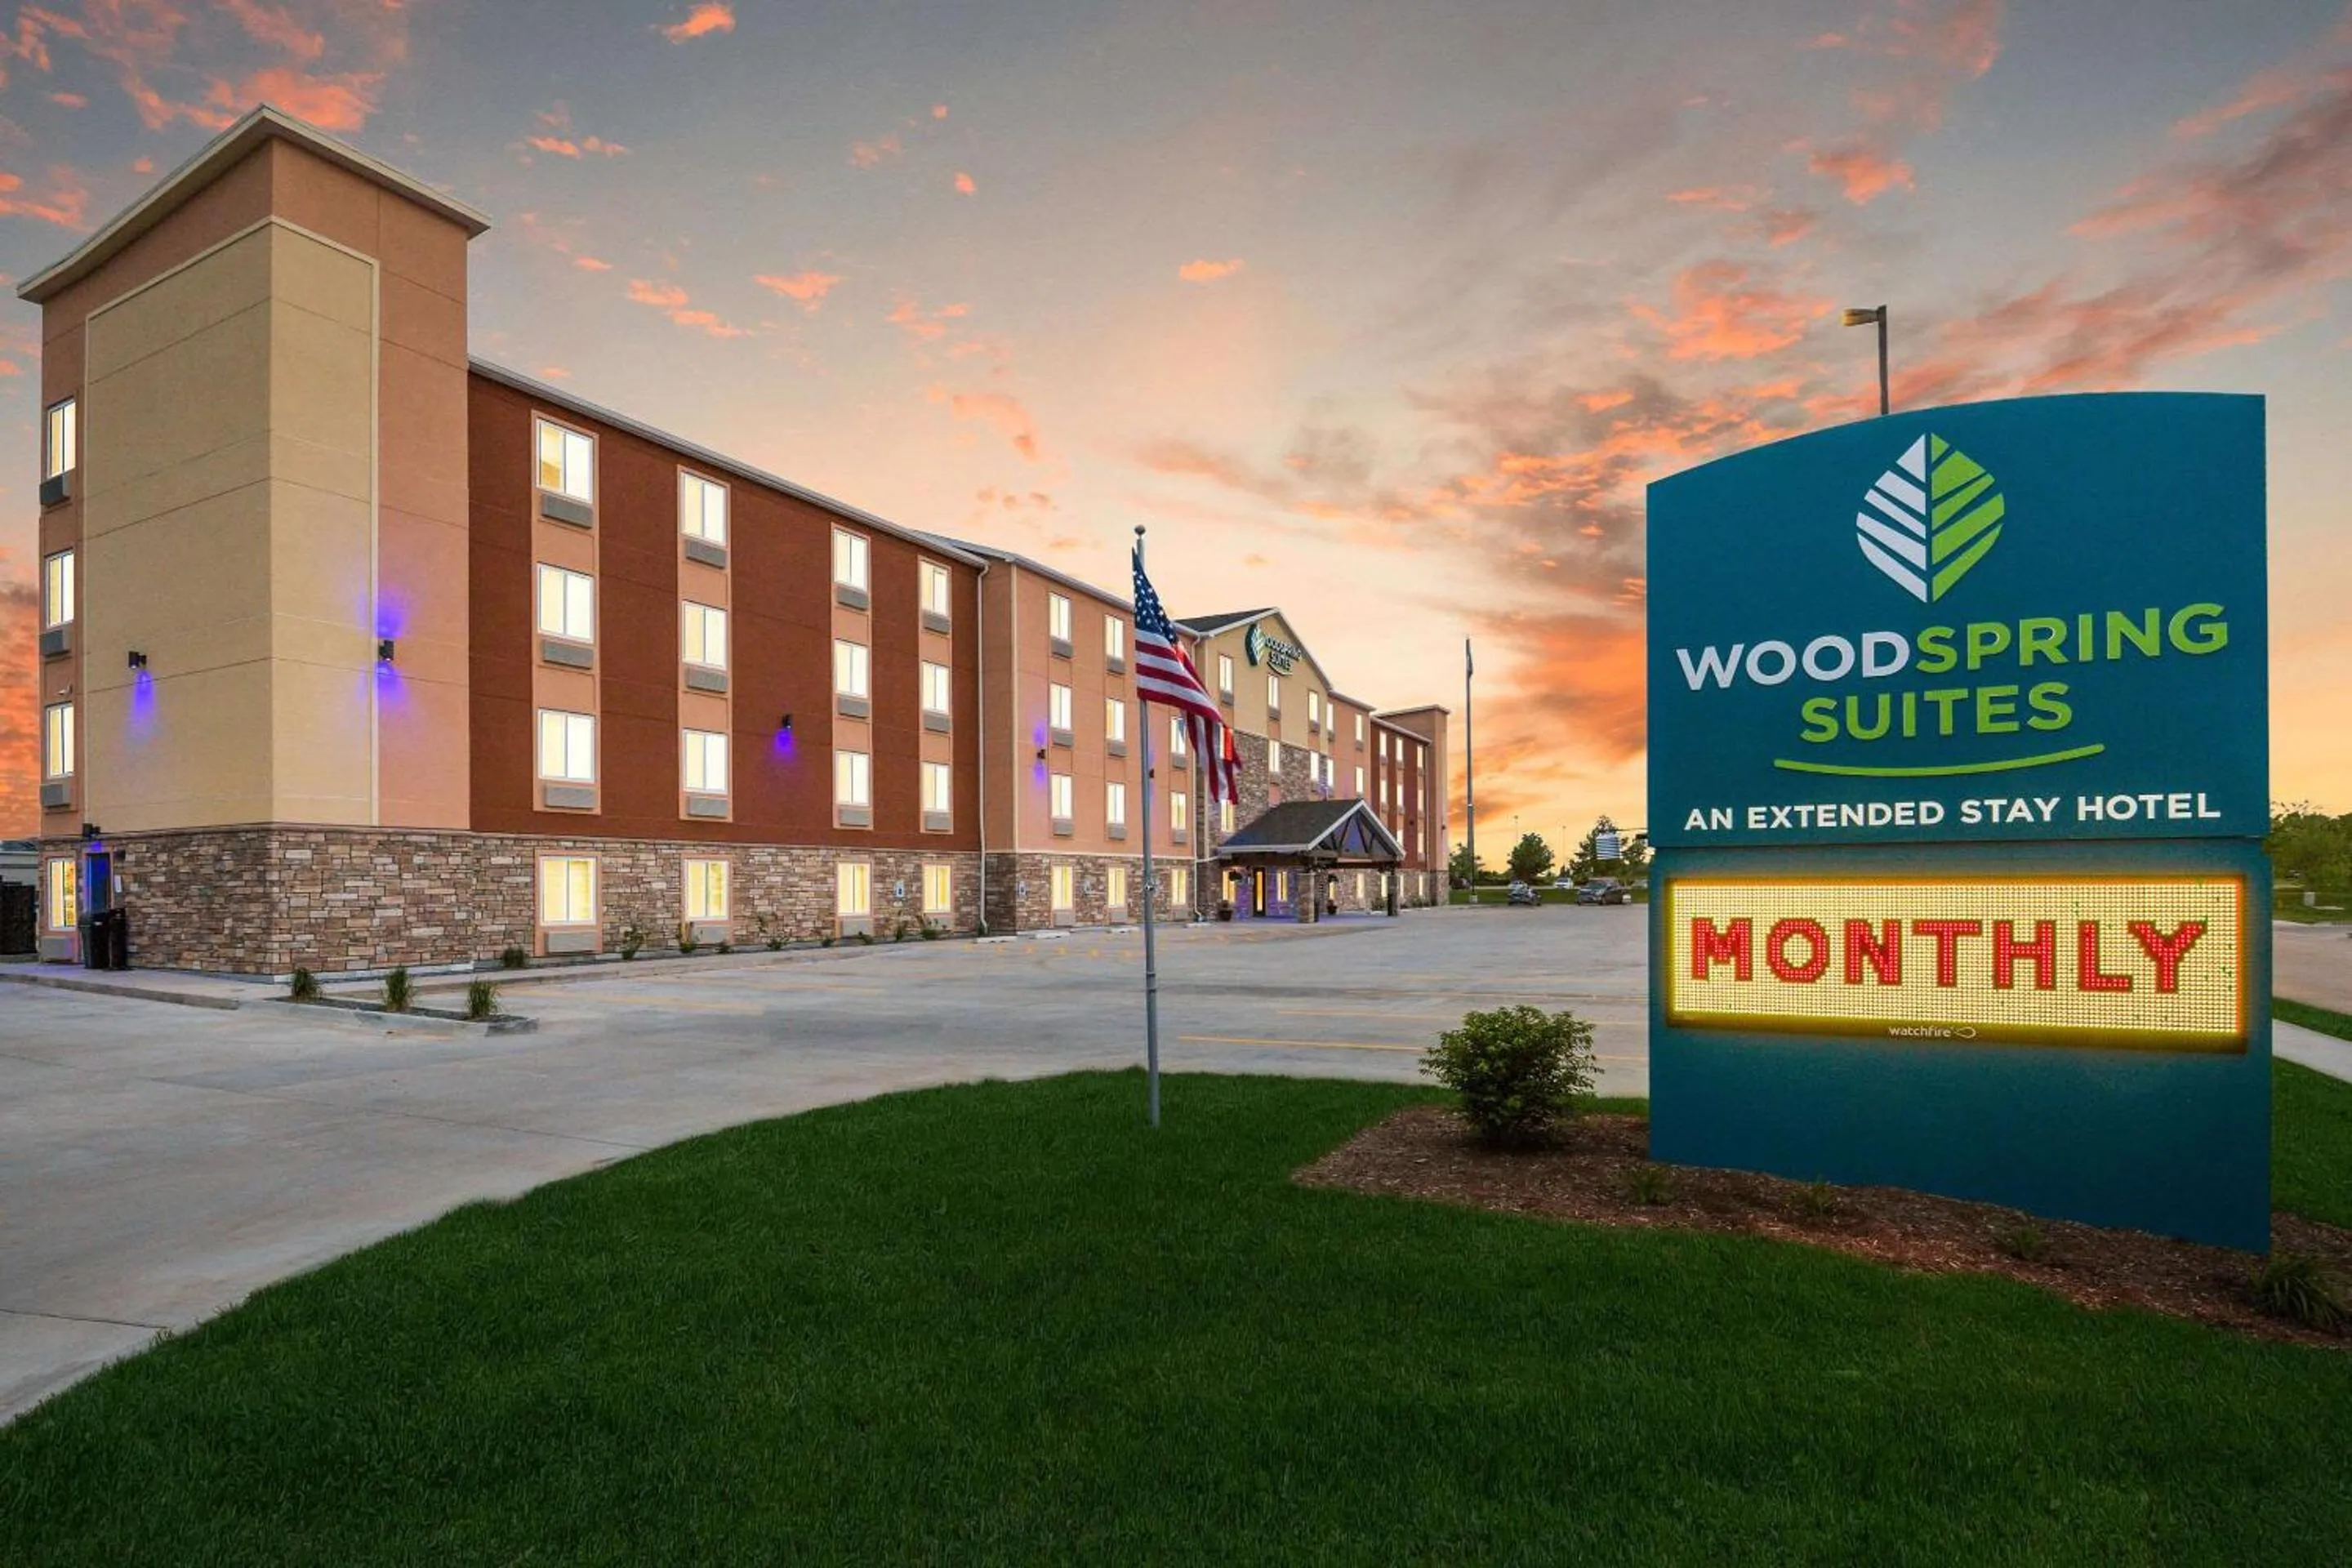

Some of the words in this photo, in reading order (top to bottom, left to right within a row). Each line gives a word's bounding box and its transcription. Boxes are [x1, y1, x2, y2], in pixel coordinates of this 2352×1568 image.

[1677, 603, 2229, 690] WOODSPRING
[1801, 681, 2073, 742] SUITES
[1684, 808, 1733, 831] AN
[1748, 801, 1945, 829] EXTENDED
[1960, 797, 2060, 824] STAY
[2078, 792, 2221, 821] HOTEL
[1690, 917, 2204, 994] MONTHLY
[1888, 1025, 1952, 1038] watchfire
